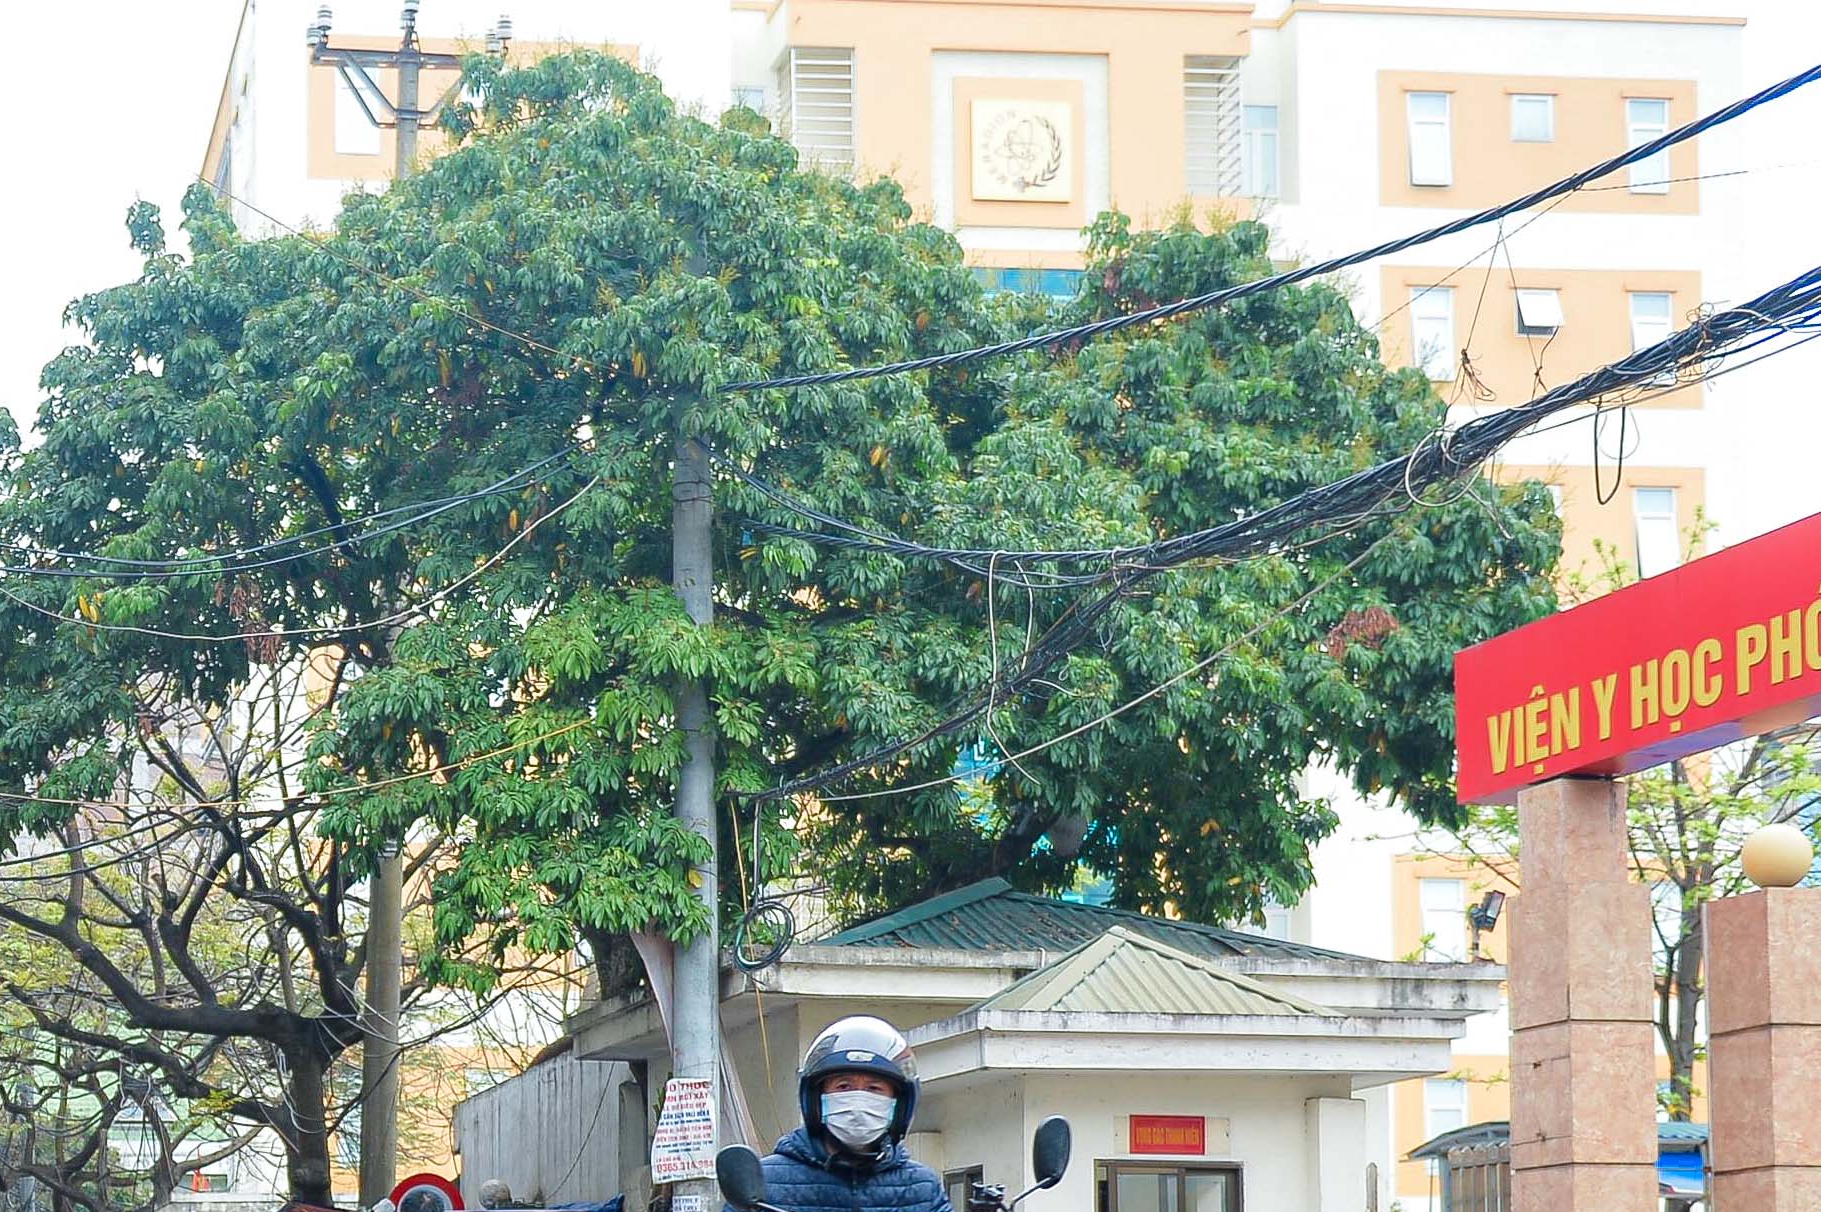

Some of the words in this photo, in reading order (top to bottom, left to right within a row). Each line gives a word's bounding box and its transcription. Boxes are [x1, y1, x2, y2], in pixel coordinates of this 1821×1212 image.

[1486, 684, 1581, 775] VIỆN
[1591, 672, 1618, 741] Y
[1630, 638, 1723, 733] HỌC
